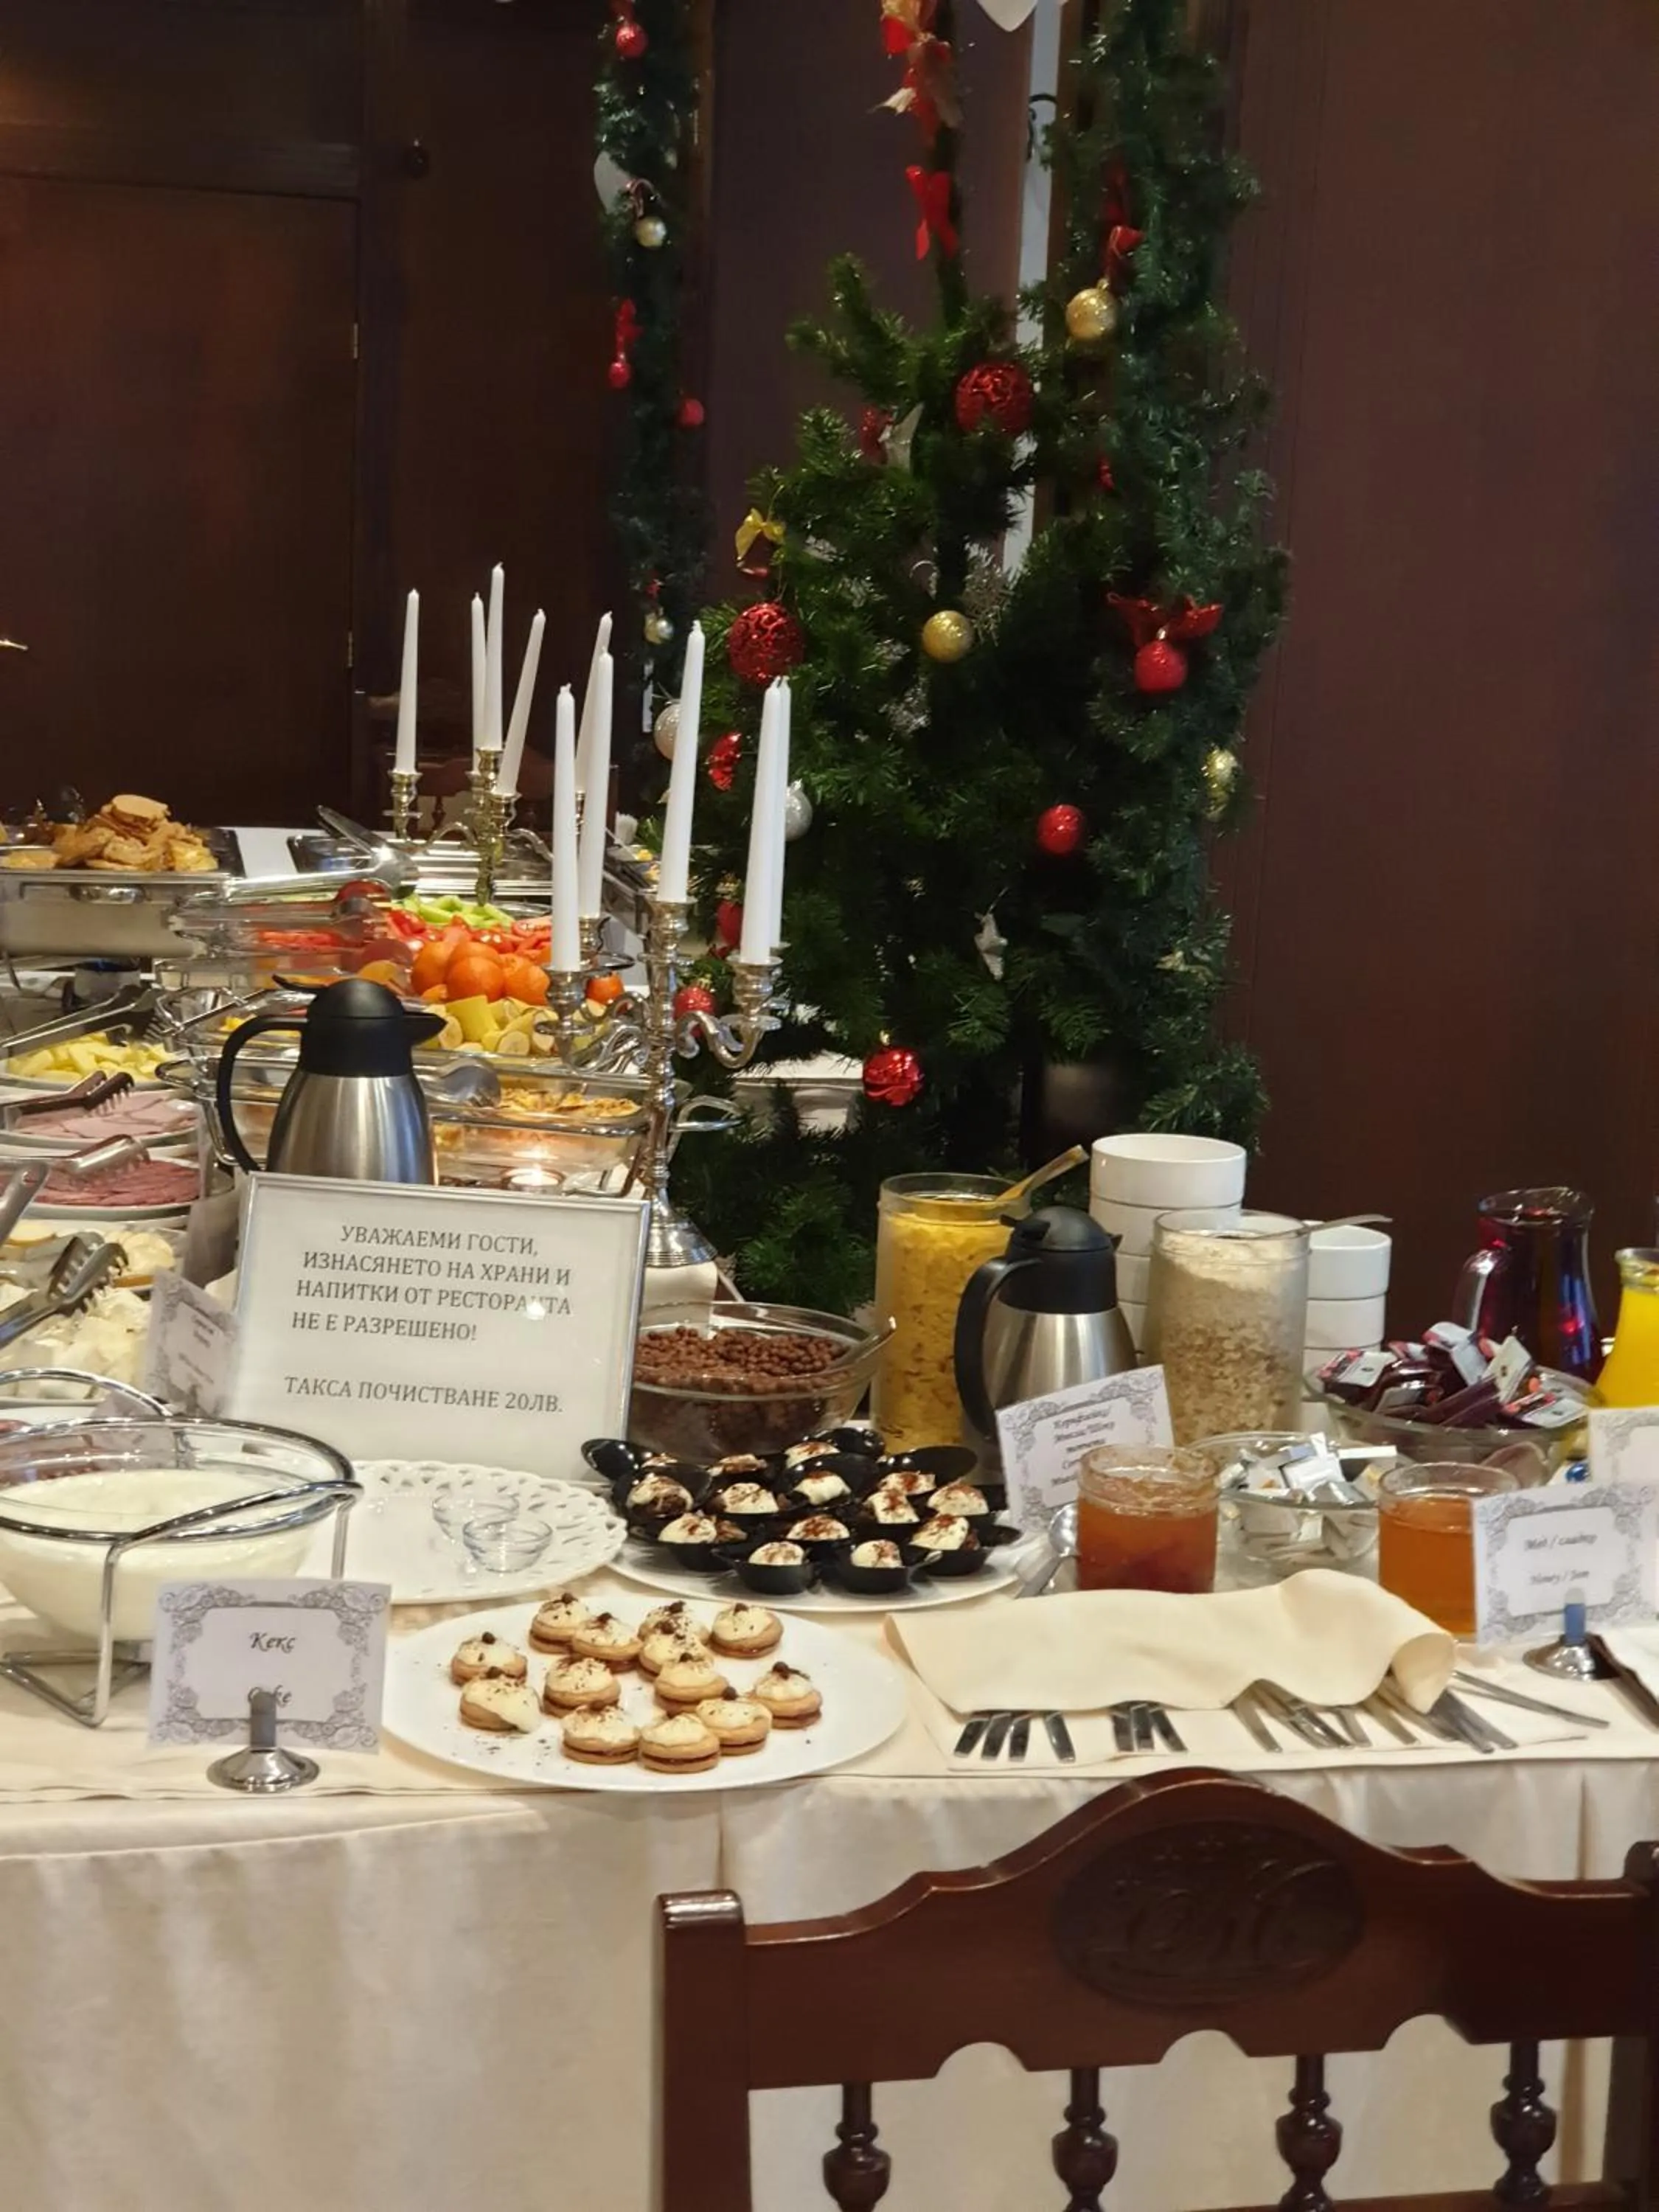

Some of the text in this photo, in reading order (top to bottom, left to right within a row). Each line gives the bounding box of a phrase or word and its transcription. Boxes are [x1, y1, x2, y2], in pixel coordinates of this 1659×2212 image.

[341, 1225, 538, 1256] УВАЖАЕМИ ГОСТИ,
[303, 1252, 571, 1286] ИЗНАСЯНЕТО НА ХРАНИ И
[296, 1279, 399, 1302] НАПИТКИ
[404, 1287, 433, 1305] ОТ
[292, 1312, 477, 1340] НЕ Е РАЗРЕШЕНО!
[285, 1377, 563, 1413] ТАКСА ПОЧИСТВАНЕ 20ЛВ.
[249, 1632, 296, 1654] Кекс
[248, 1684, 292, 1708] Cke
